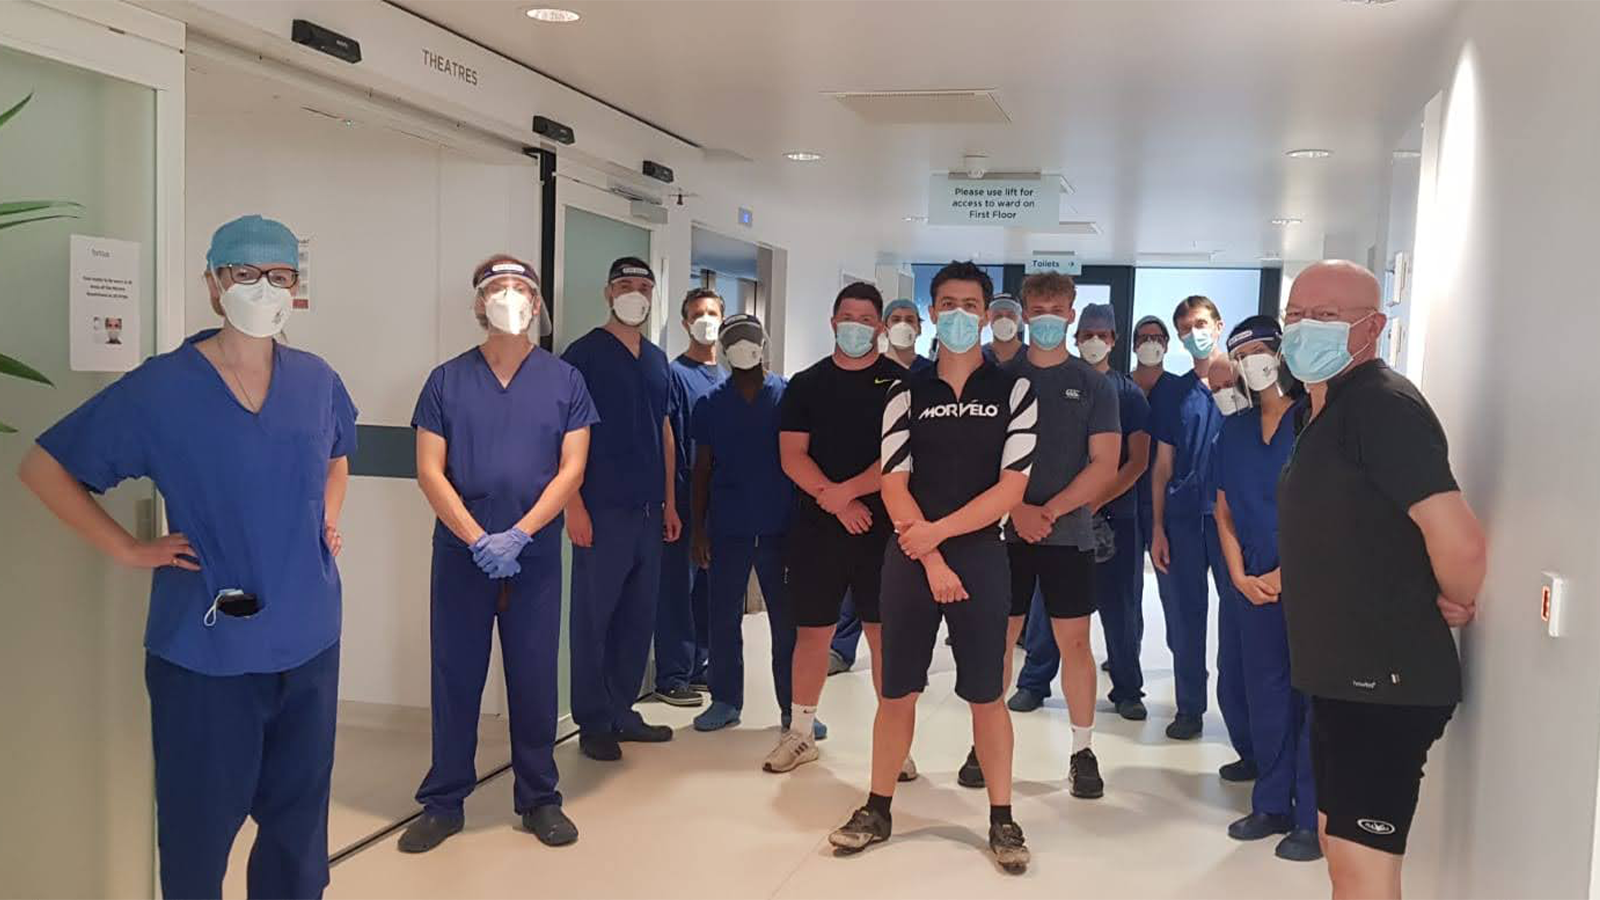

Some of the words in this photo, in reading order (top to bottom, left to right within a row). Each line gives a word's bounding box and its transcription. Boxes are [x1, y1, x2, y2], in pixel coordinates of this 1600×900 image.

[422, 49, 478, 86] THEATRES
[955, 187, 985, 197] Please
[986, 188, 1002, 197] use
[1005, 187, 1018, 197] lift
[1020, 187, 1034, 197] for
[952, 200, 983, 208] access
[985, 199, 995, 208] to
[997, 199, 1021, 208] ward
[1022, 200, 1035, 208] on
[969, 210, 990, 219] First
[992, 210, 1017, 219] Floor
[1032, 259, 1060, 268] Toilets
[918, 399, 998, 420] MORVÉLO
